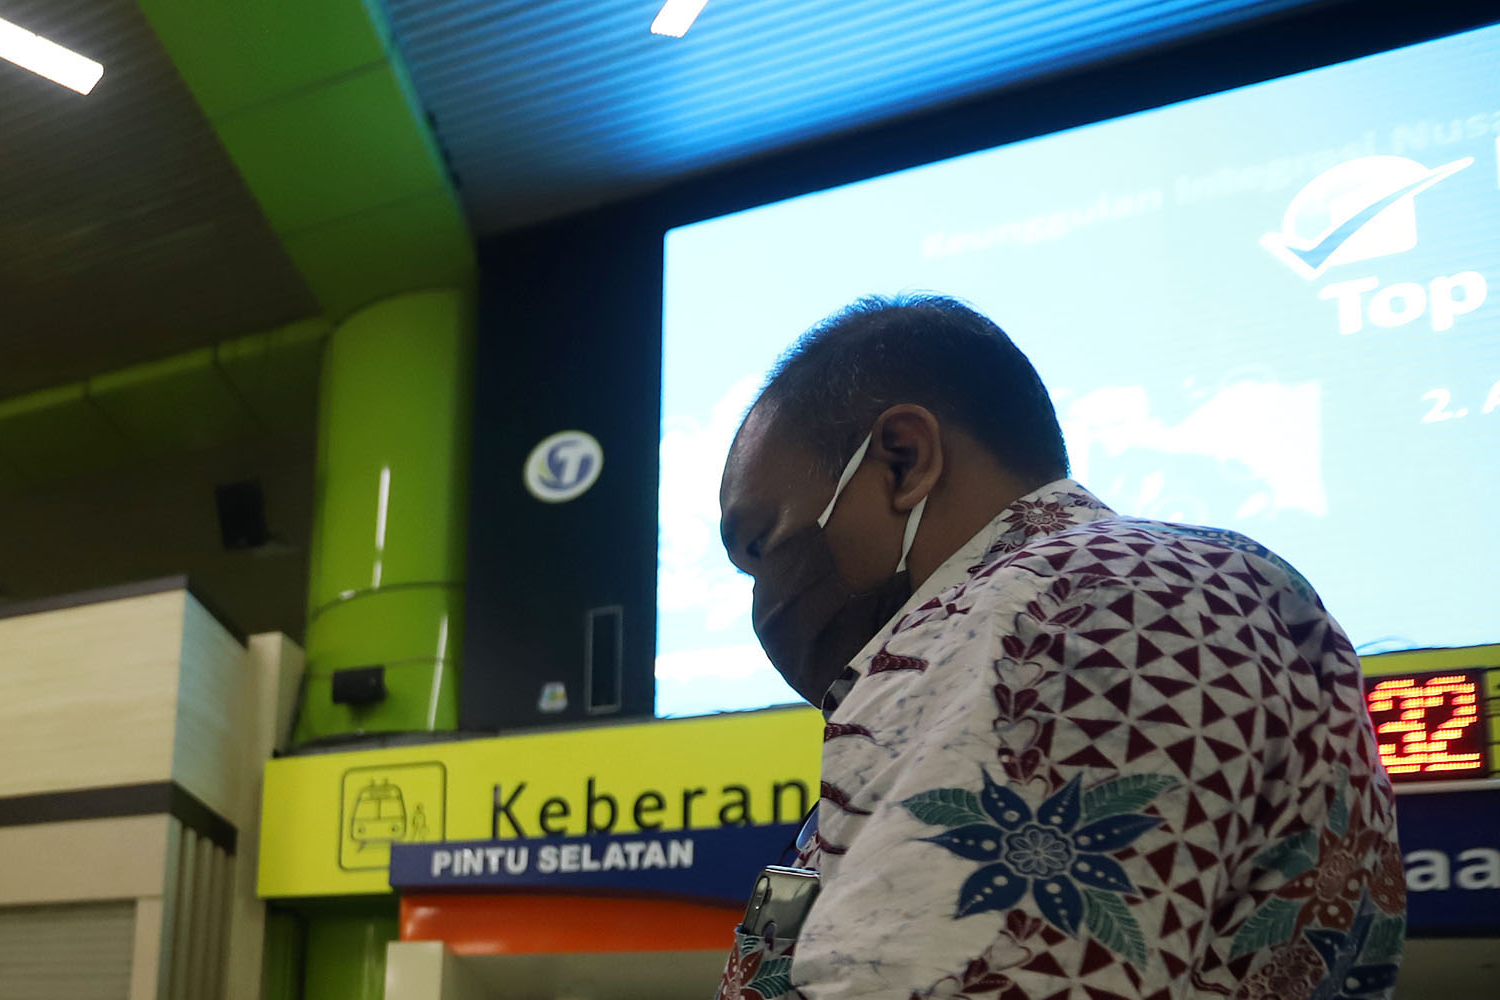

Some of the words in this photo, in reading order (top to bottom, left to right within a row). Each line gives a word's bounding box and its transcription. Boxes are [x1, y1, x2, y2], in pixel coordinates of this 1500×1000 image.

[1318, 270, 1488, 335] Top
[491, 775, 811, 841] Keberan
[432, 847, 529, 877] PINTU
[538, 839, 695, 874] SELATAN
